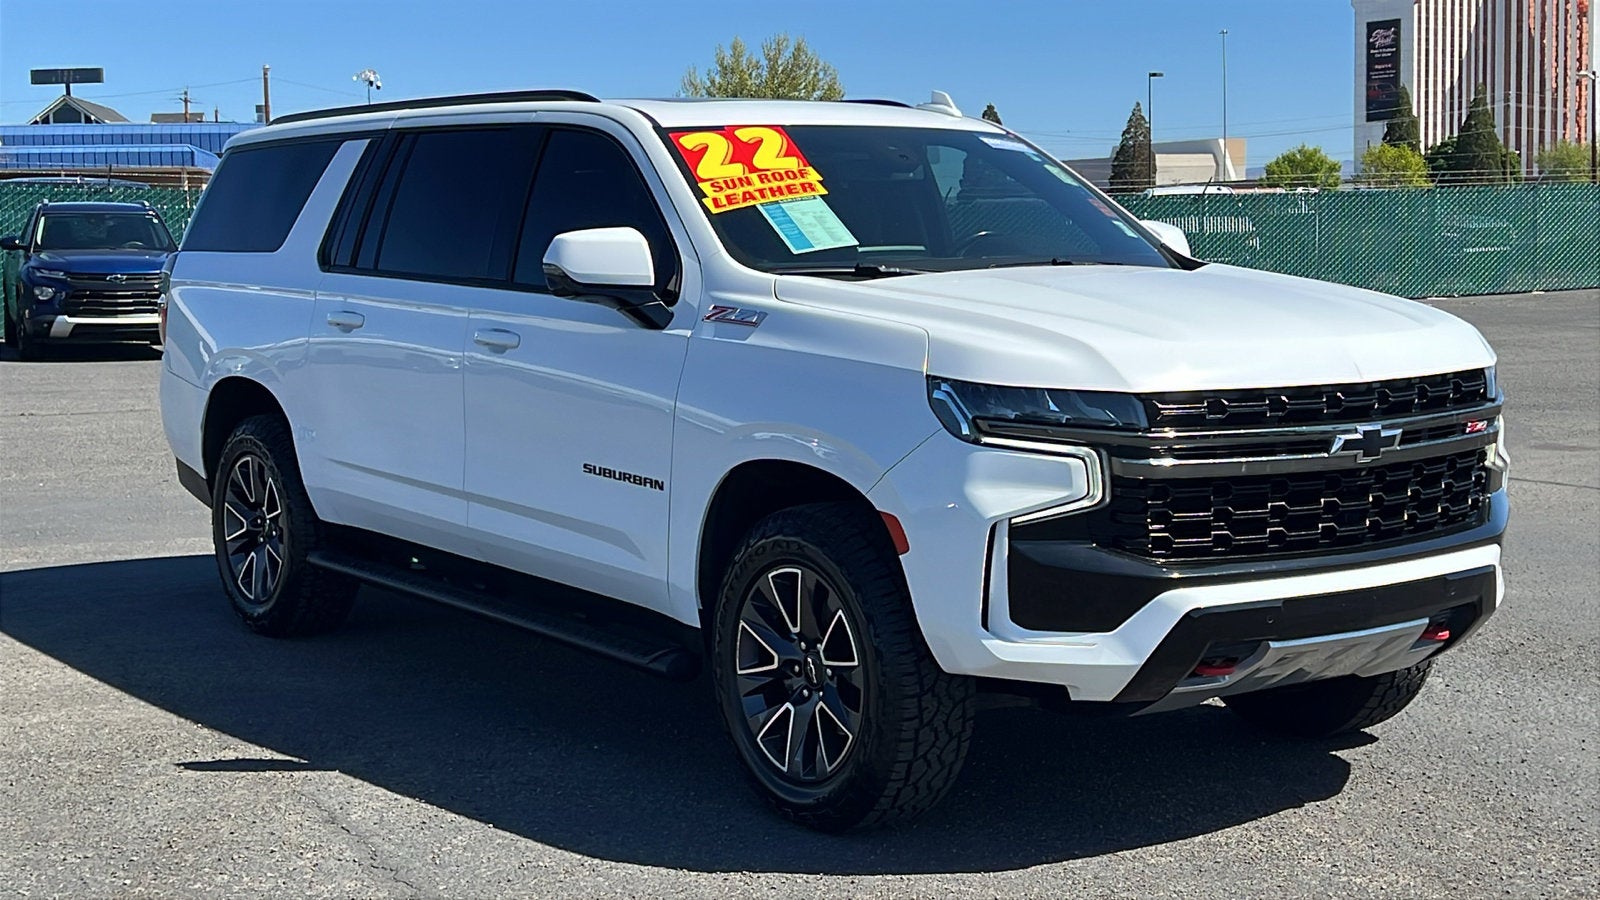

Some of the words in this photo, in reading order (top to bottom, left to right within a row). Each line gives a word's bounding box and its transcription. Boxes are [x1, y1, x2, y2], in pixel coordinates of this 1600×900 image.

[679, 126, 804, 181] 22
[710, 175, 755, 193] SUN
[759, 168, 812, 184] ROOF
[711, 181, 818, 209] LEATHER
[583, 463, 664, 491] SUBURBAN
